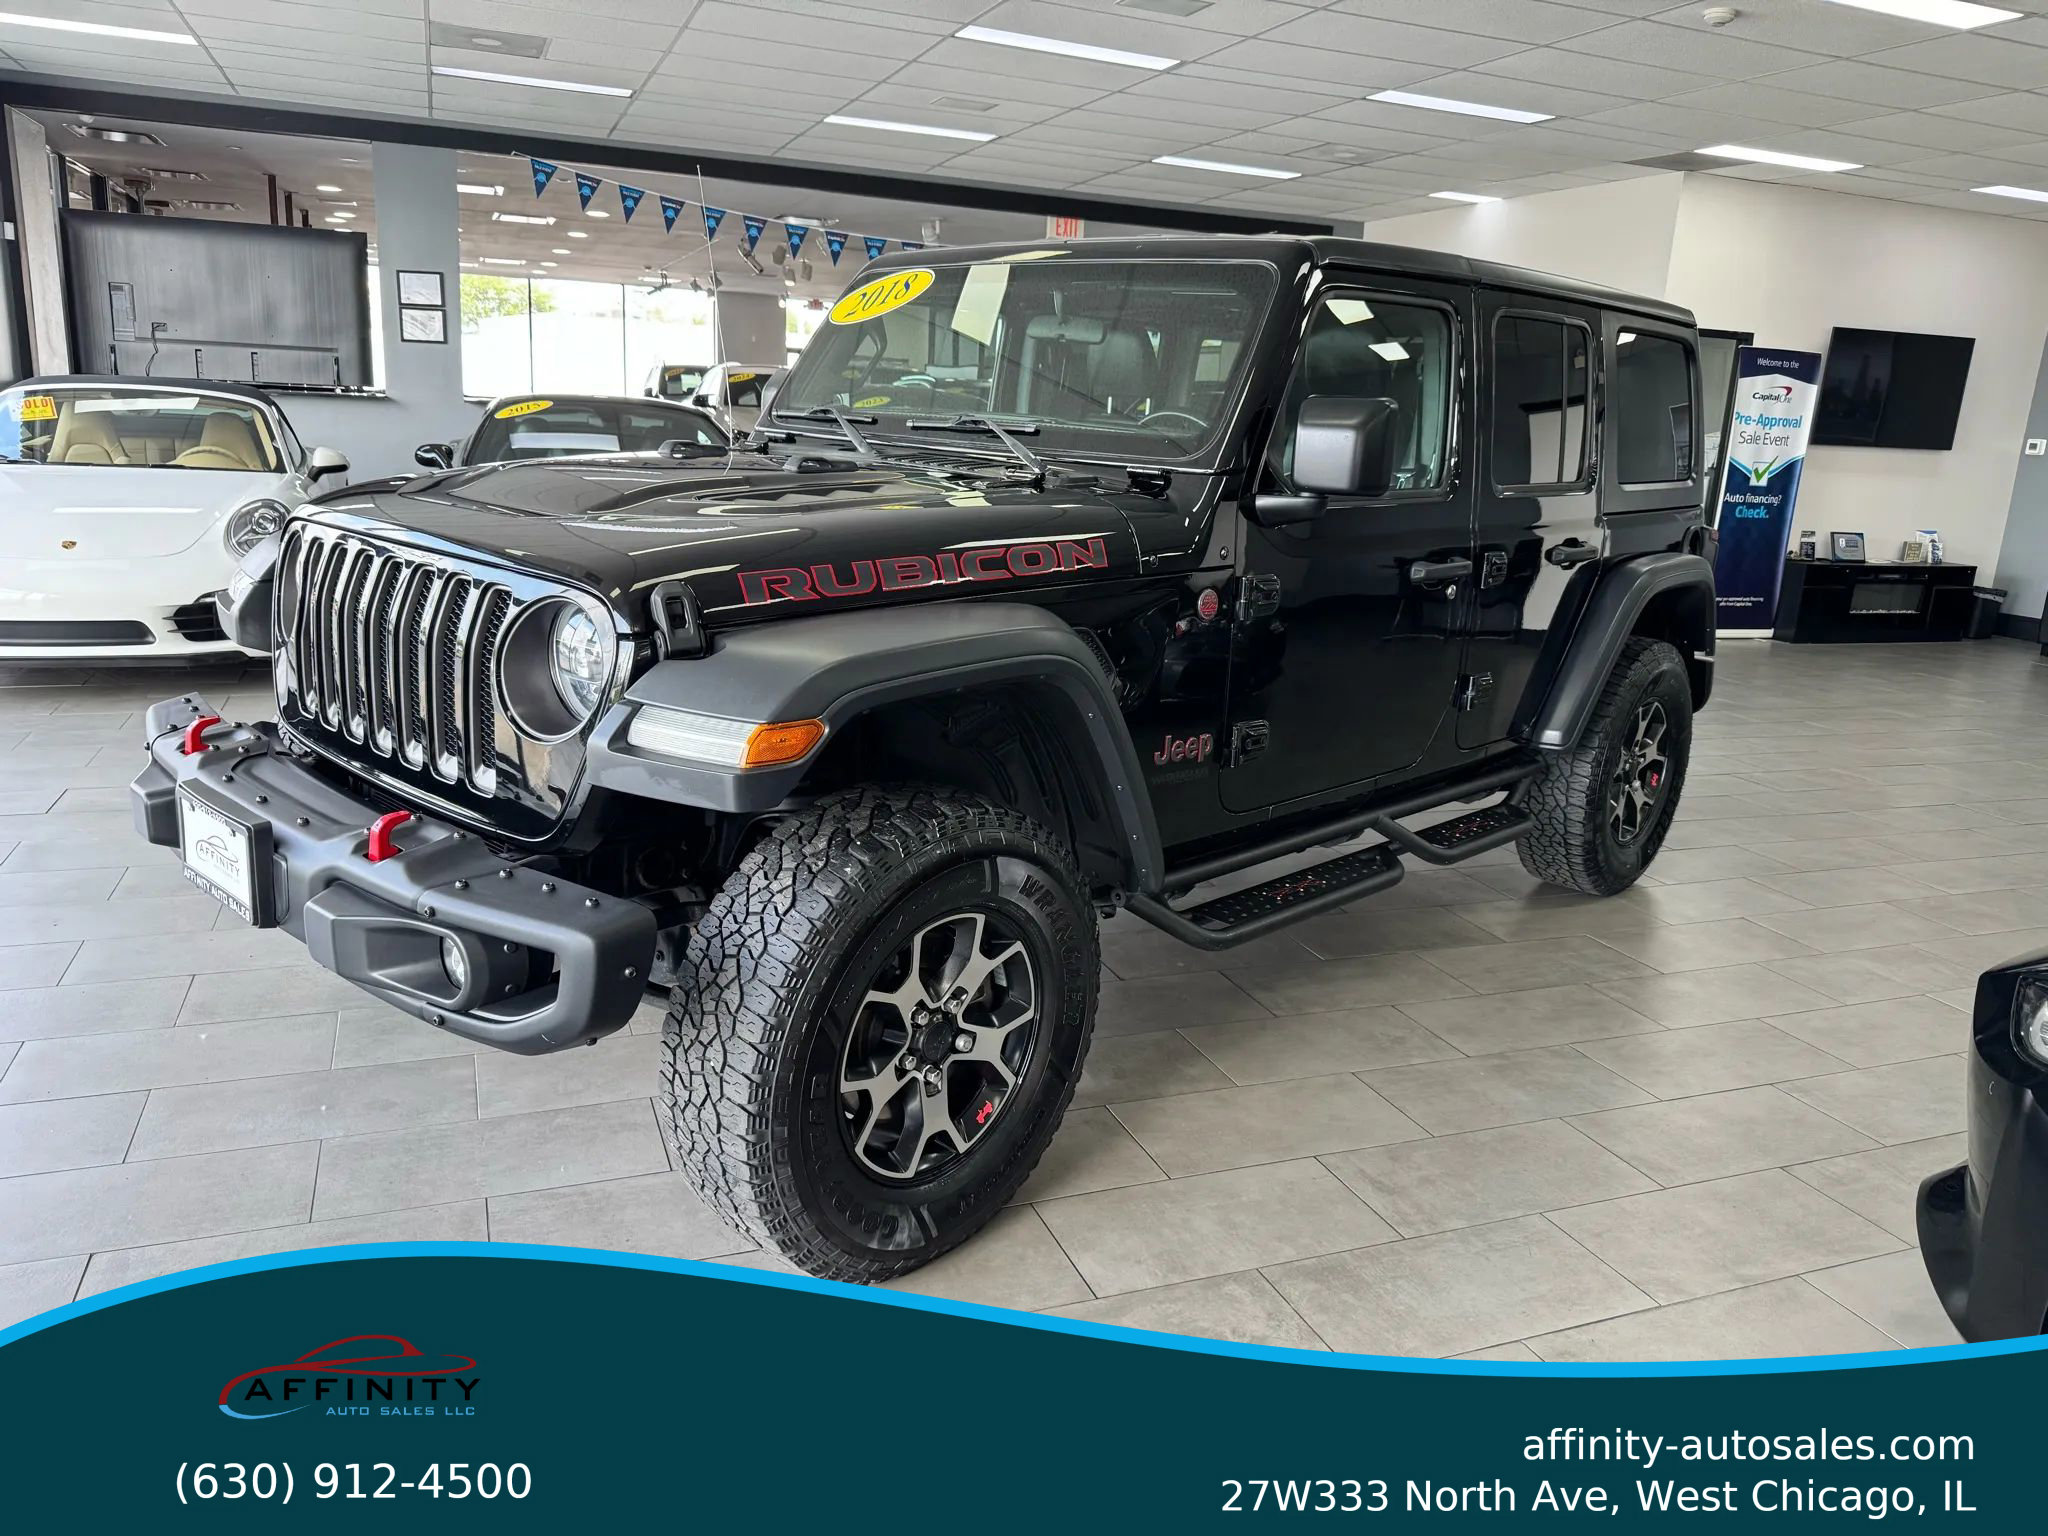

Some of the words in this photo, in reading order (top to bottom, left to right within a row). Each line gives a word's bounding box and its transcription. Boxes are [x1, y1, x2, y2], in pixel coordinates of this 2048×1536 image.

[1055, 215, 1081, 238] EXIT
[843, 273, 918, 319] 2018
[1757, 357, 1782, 368] Welcome
[1783, 359, 1789, 368] to
[1790, 359, 1799, 369] the
[1735, 411, 1803, 431] Pre-Approval
[1738, 430, 1760, 445] Sale
[1762, 432, 1790, 447] Event
[1724, 492, 1744, 503] Auto
[1745, 493, 1782, 506] financing?
[1735, 505, 1769, 518] Check.
[738, 538, 1108, 606] RUBICON
[1153, 733, 1214, 766] Jeep
[199, 843, 240, 878] AFFINITY
[184, 867, 212, 894] AFFINITY
[211, 884, 229, 904] AUTO
[229, 896, 250, 922] SALES
